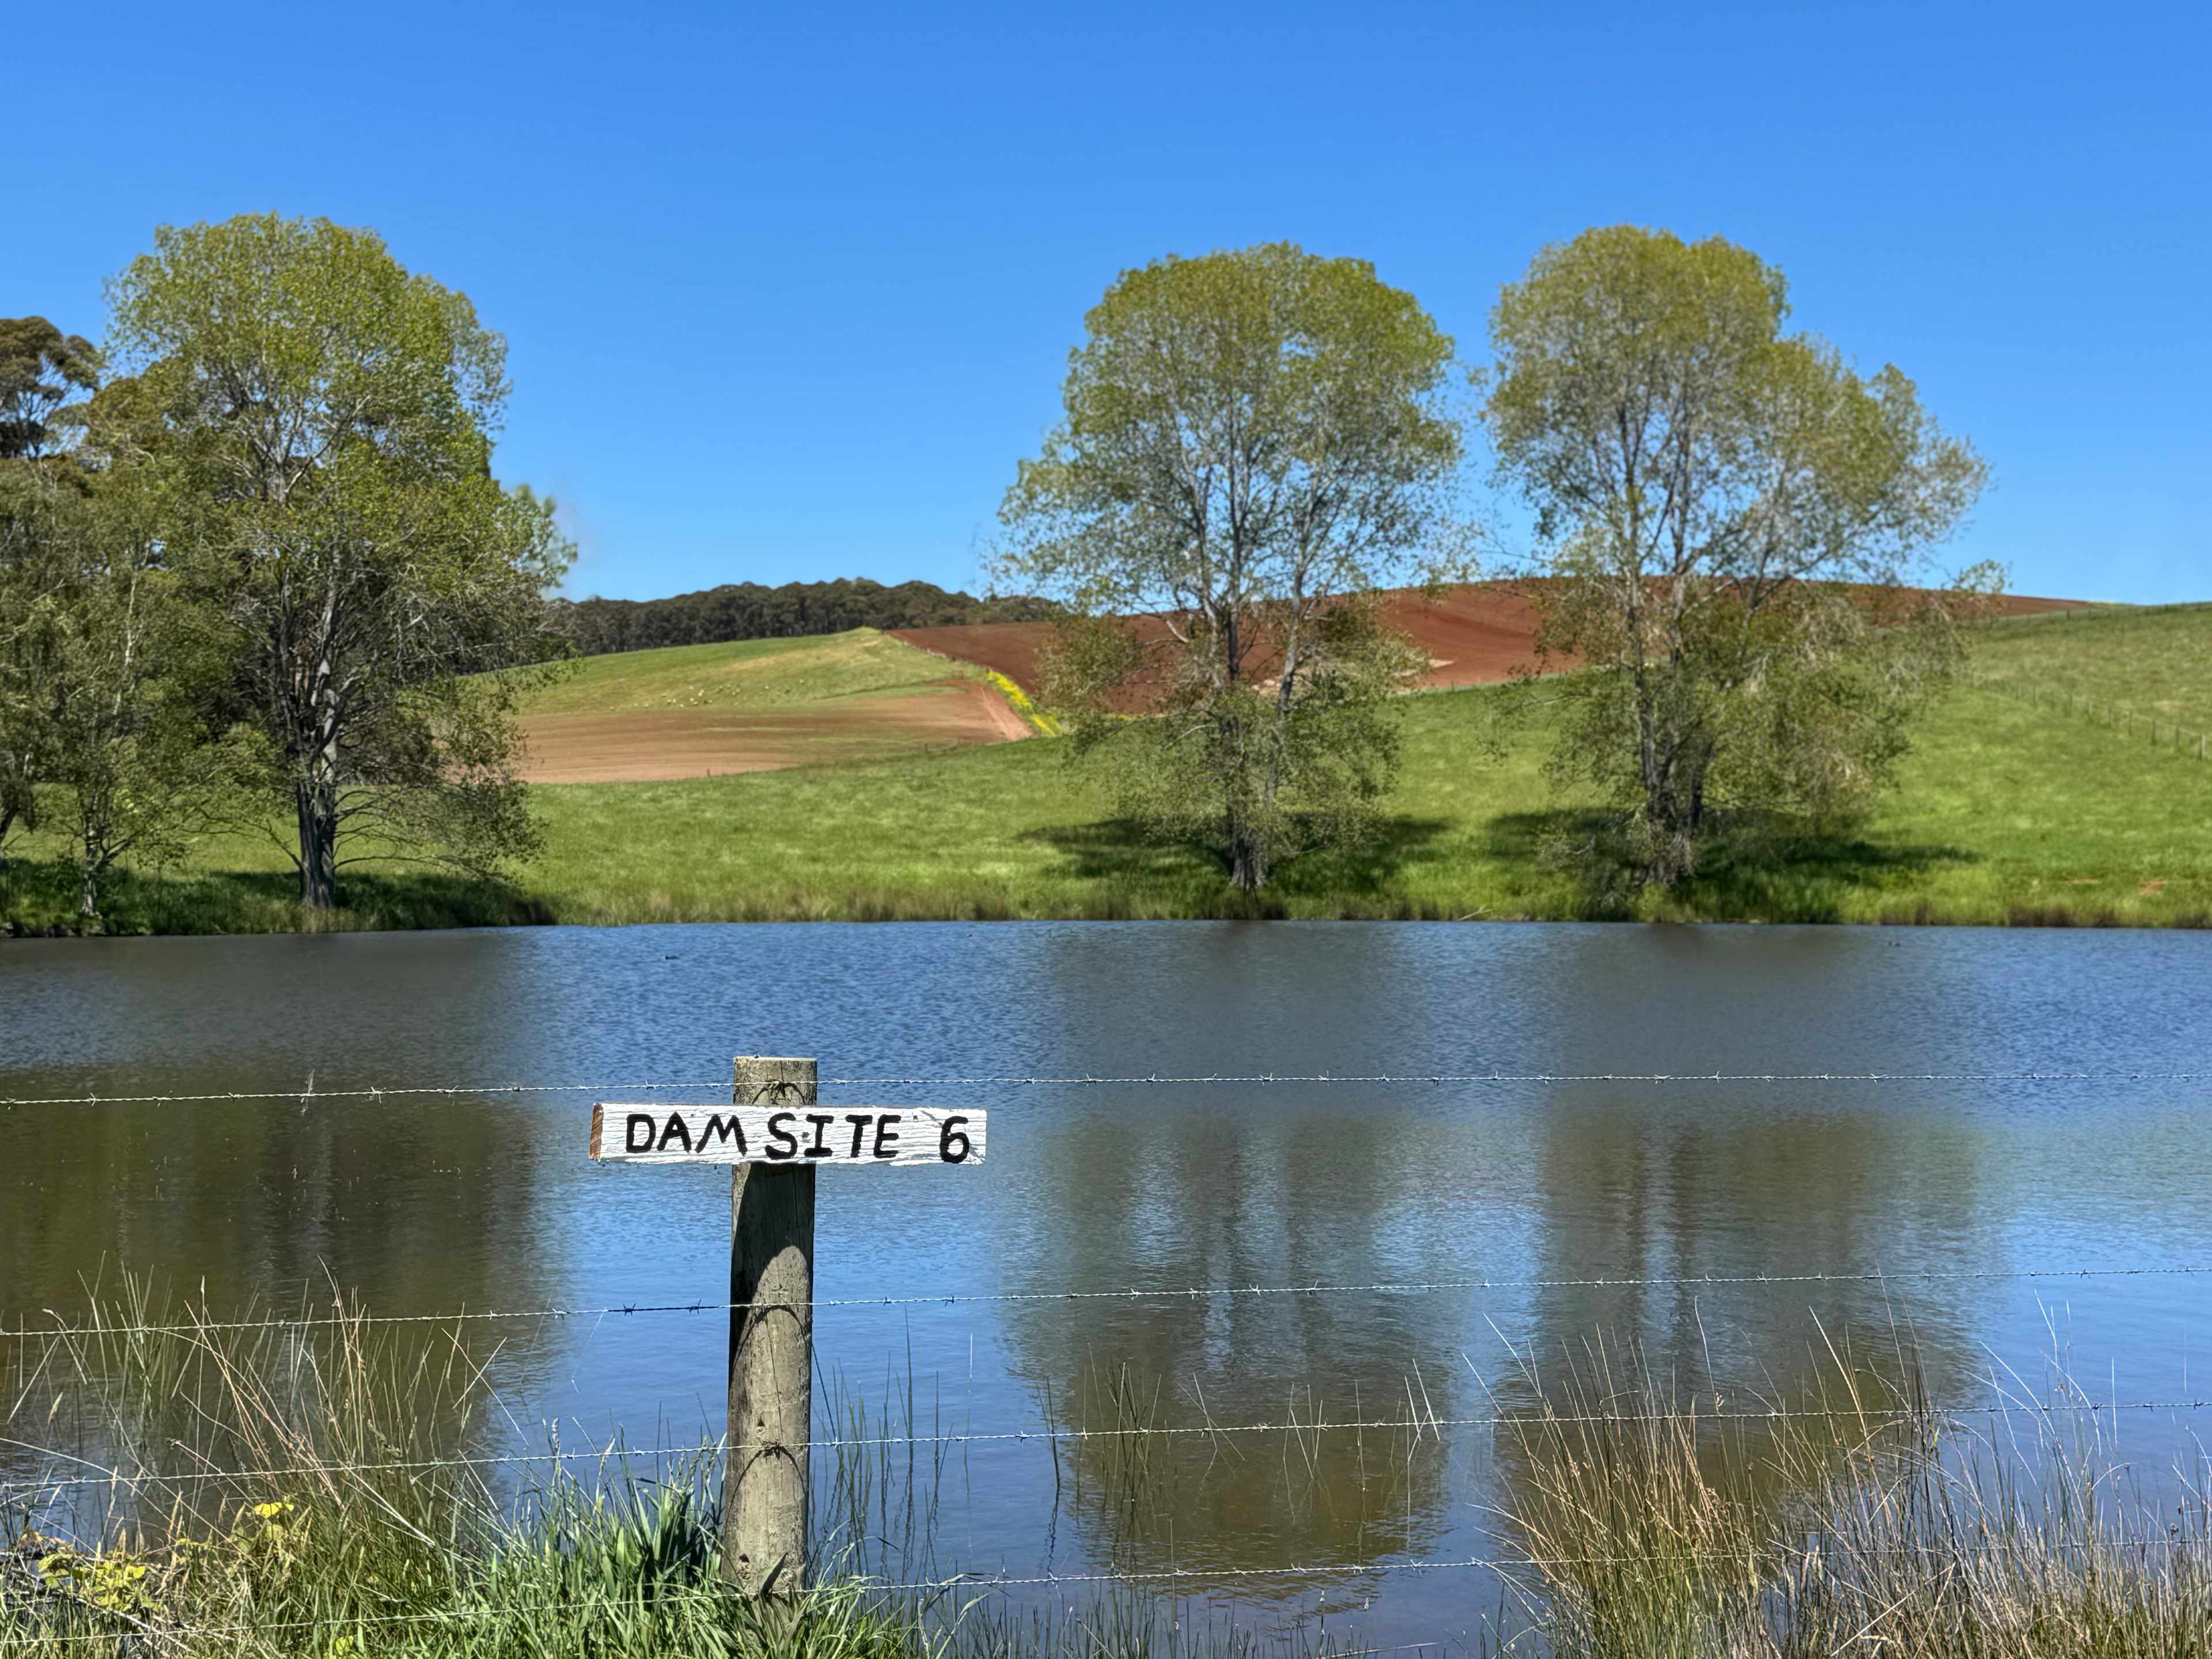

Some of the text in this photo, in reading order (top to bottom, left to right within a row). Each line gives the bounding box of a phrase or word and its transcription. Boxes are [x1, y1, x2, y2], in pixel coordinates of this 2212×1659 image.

[625, 1112, 970, 1164] DAM SITE 6
